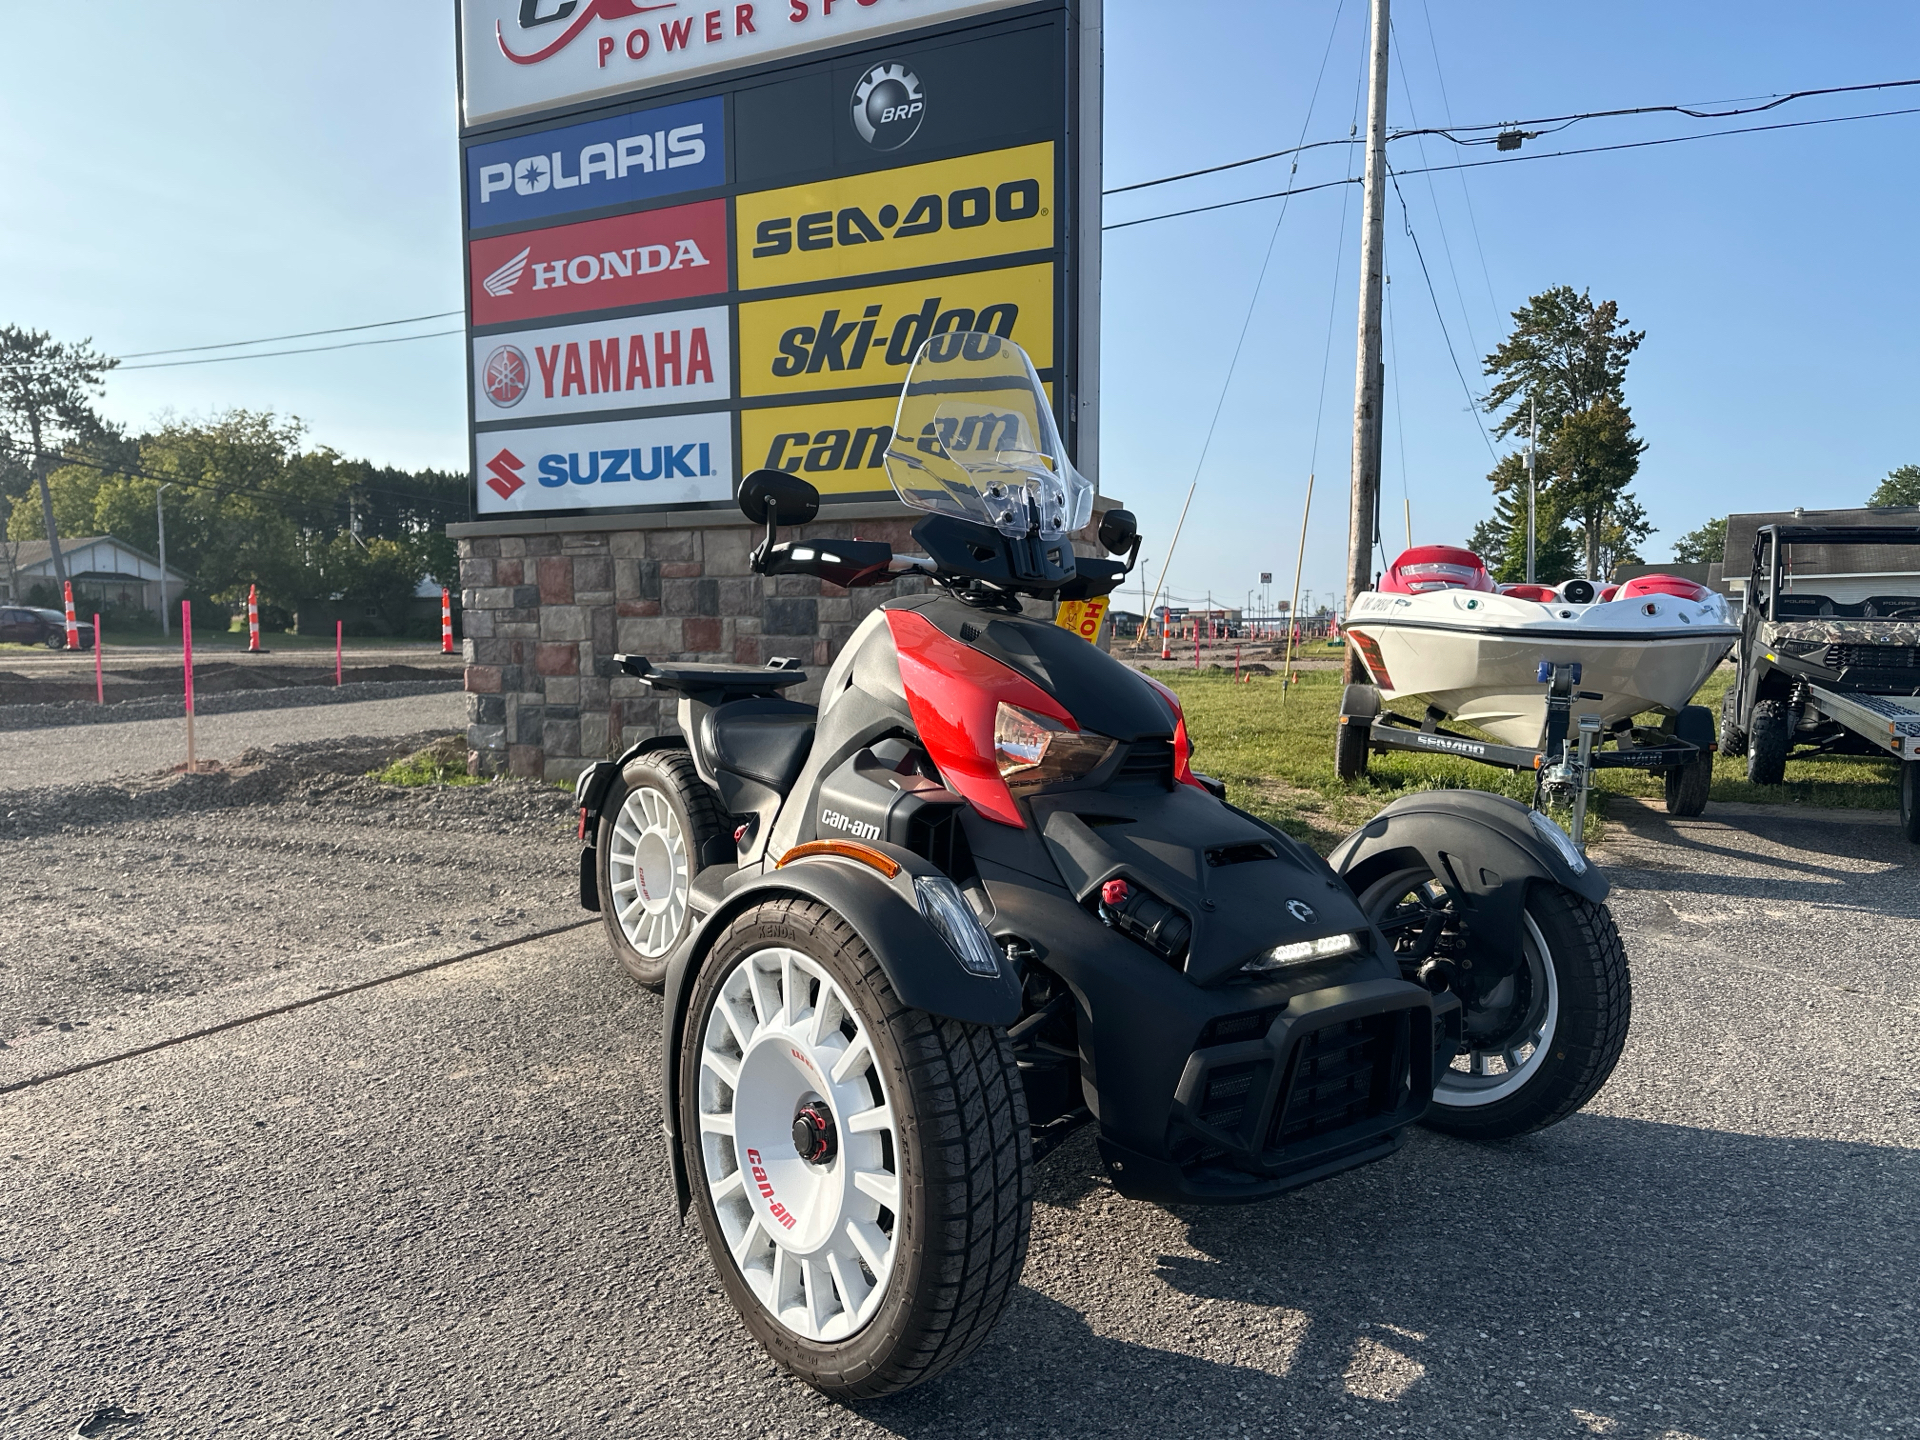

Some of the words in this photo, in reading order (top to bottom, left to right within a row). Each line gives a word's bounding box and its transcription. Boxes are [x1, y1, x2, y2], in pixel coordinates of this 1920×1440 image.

[598, 4, 756, 69] POWER
[880, 102, 923, 124] BRP
[479, 123, 706, 203] POLARIS
[531, 238, 710, 291] HONDA
[534, 327, 714, 399] YAMAHA
[538, 442, 711, 488] SUZUKI
[821, 809, 882, 840] can-am
[758, 924, 796, 941] KENDA
[746, 1148, 797, 1230] can-am
